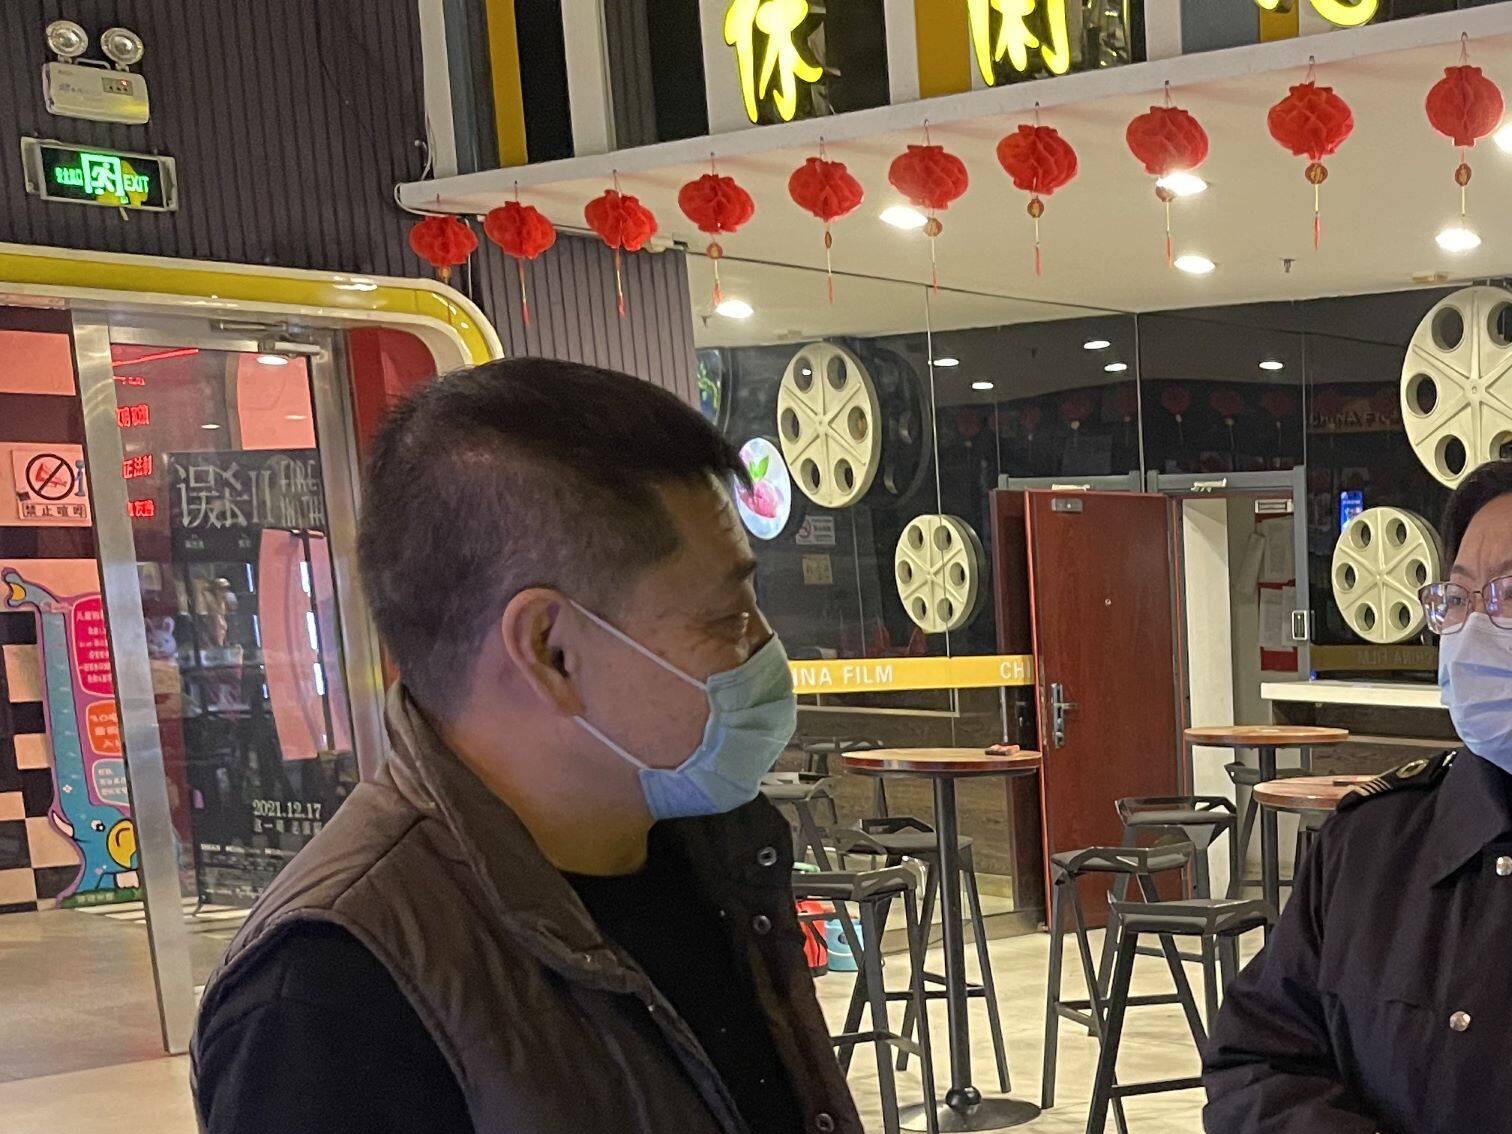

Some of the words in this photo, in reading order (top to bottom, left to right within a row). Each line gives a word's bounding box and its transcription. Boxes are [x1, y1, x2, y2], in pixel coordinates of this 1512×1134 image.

[123, 174, 149, 193] EXIT
[25, 504, 84, 517] 禁止喧哗
[843, 665, 894, 684] FILM
[253, 800, 322, 819] 2021.12.17
